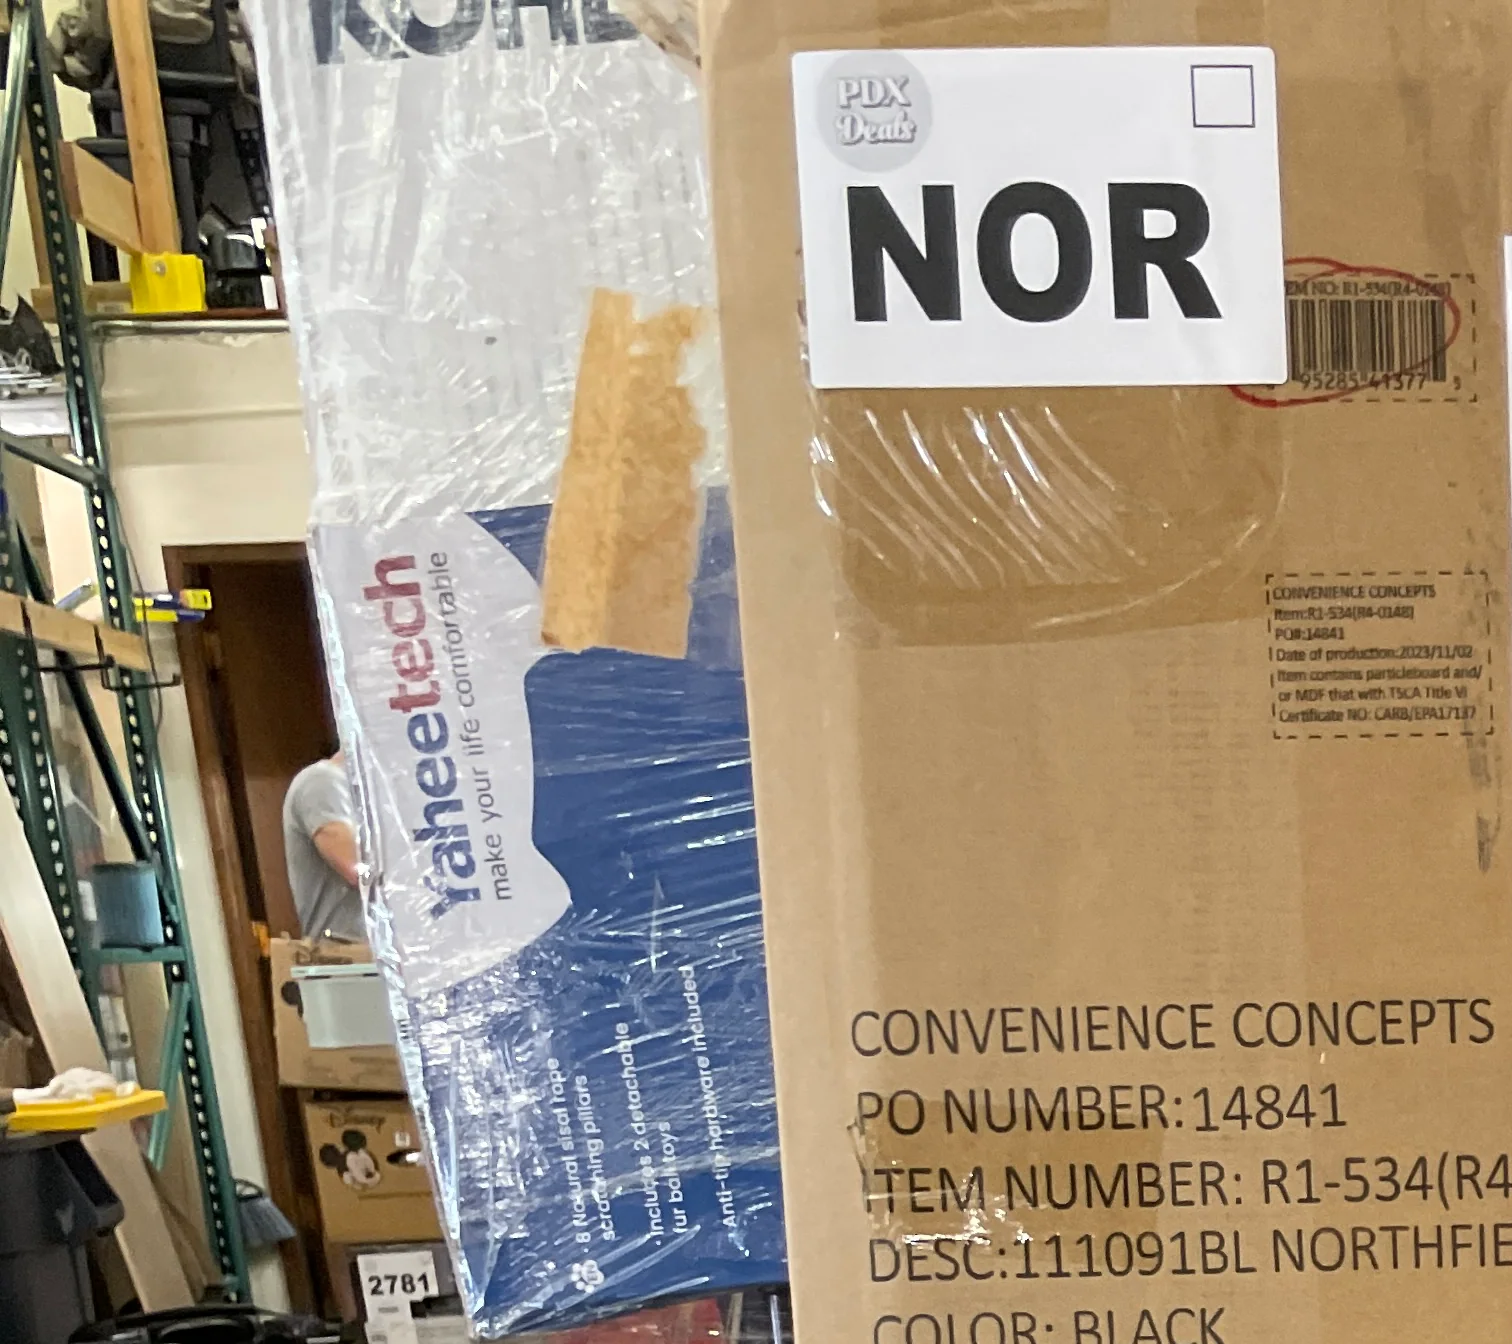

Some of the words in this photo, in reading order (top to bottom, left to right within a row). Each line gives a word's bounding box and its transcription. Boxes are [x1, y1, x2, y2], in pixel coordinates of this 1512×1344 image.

[837, 75, 911, 108] PDX
[834, 111, 916, 145] Deals
[847, 181, 1222, 323] NOR
[1312, 281, 1339, 296] NO:
[1301, 373, 1359, 391] 95285
[1273, 585, 1365, 601] CONVENIENCE
[1368, 584, 1436, 599] CONCEPTS
[428, 551, 475, 709] comfortable
[1276, 648, 1306, 662] Date
[1309, 648, 1322, 661] of
[1366, 666, 1450, 682] particleboard
[1278, 690, 1292, 702] or
[1279, 708, 1344, 722] Certificate
[363, 555, 481, 920] Yaheetech
[461, 718, 484, 758] life
[474, 766, 505, 824] your
[484, 832, 512, 901] make
[679, 964, 709, 1052] included
[851, 1002, 1216, 1057] CONVENIENCE
[1233, 998, 1496, 1049] CONCEPTS
[615, 1022, 646, 1135] detachable
[576, 1074, 602, 1135] pillars
[699, 1055, 725, 1151] hardware
[857, 1090, 925, 1136] PO
[944, 1083, 1347, 1134] NUMBER:14841
[634, 1137, 649, 1151] 2
[1005, 1159, 1243, 1210] NUMBER:
[576, 1229, 591, 1243] 8
[869, 1229, 1257, 1283] DESC:111091BL
[367, 1272, 430, 1297] 2781
